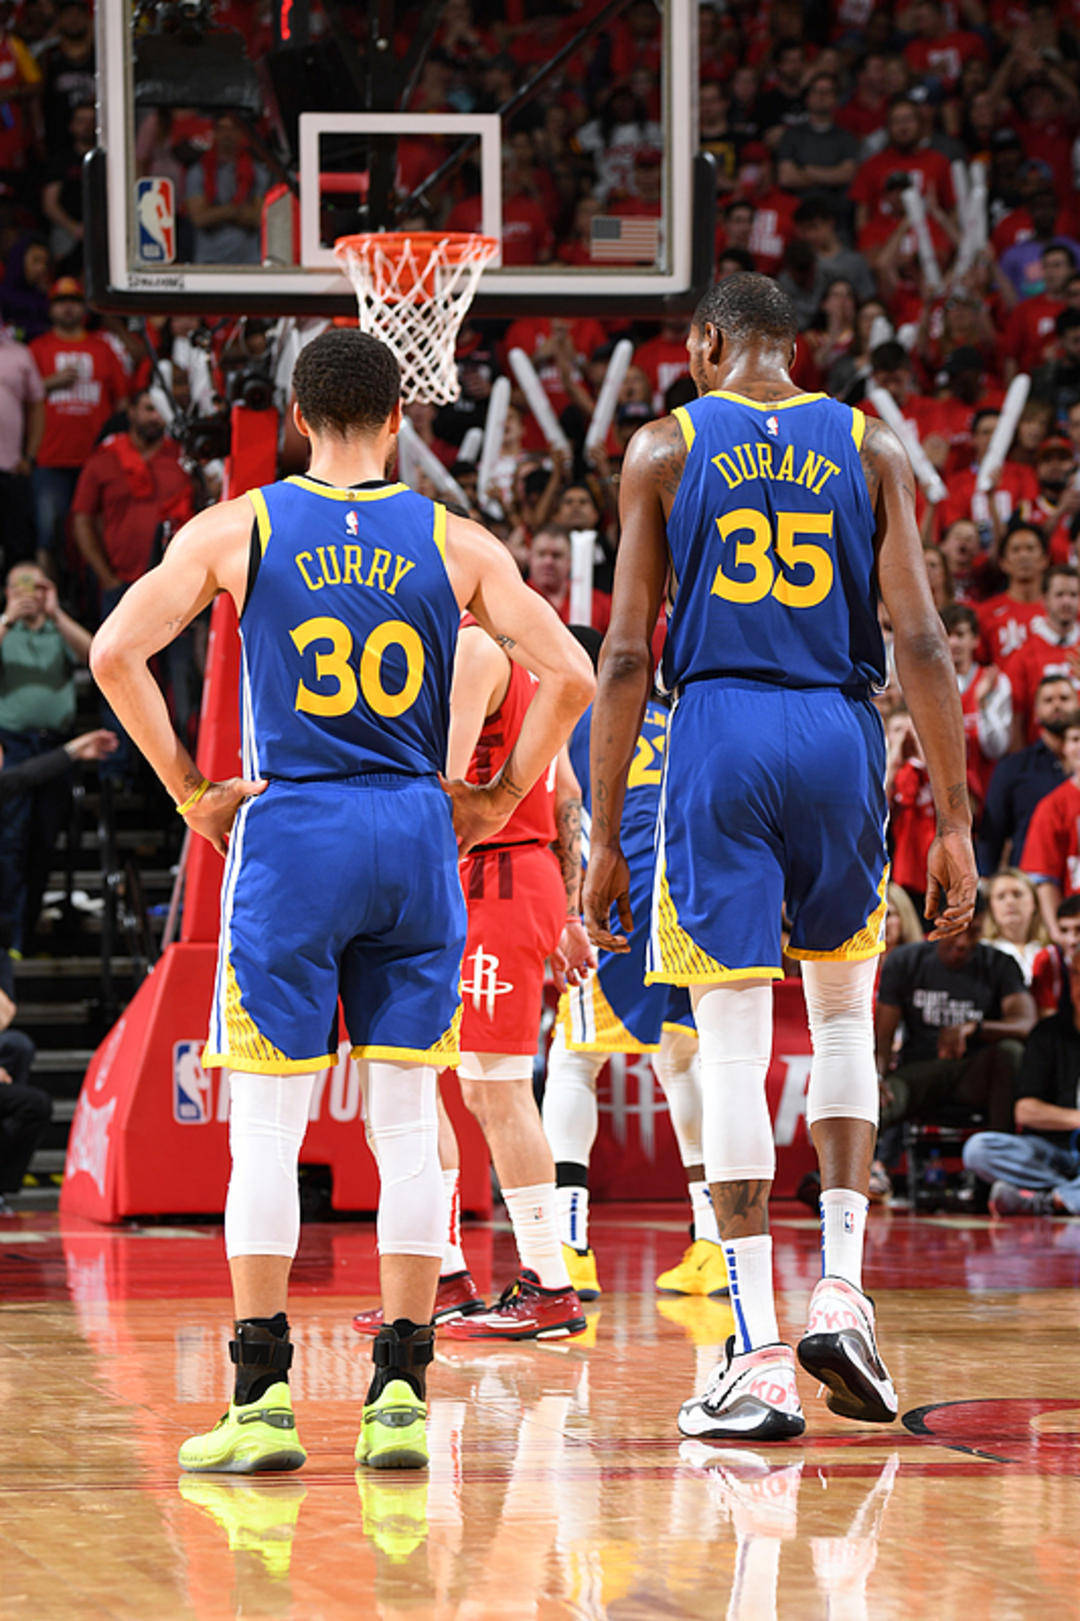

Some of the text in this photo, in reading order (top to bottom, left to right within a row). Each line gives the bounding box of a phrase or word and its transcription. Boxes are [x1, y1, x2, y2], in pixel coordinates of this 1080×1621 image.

[710, 442, 841, 495] DURANT
[294, 544, 416, 596] CURRY
[710, 507, 834, 609] 35
[288, 615, 426, 719] 30
